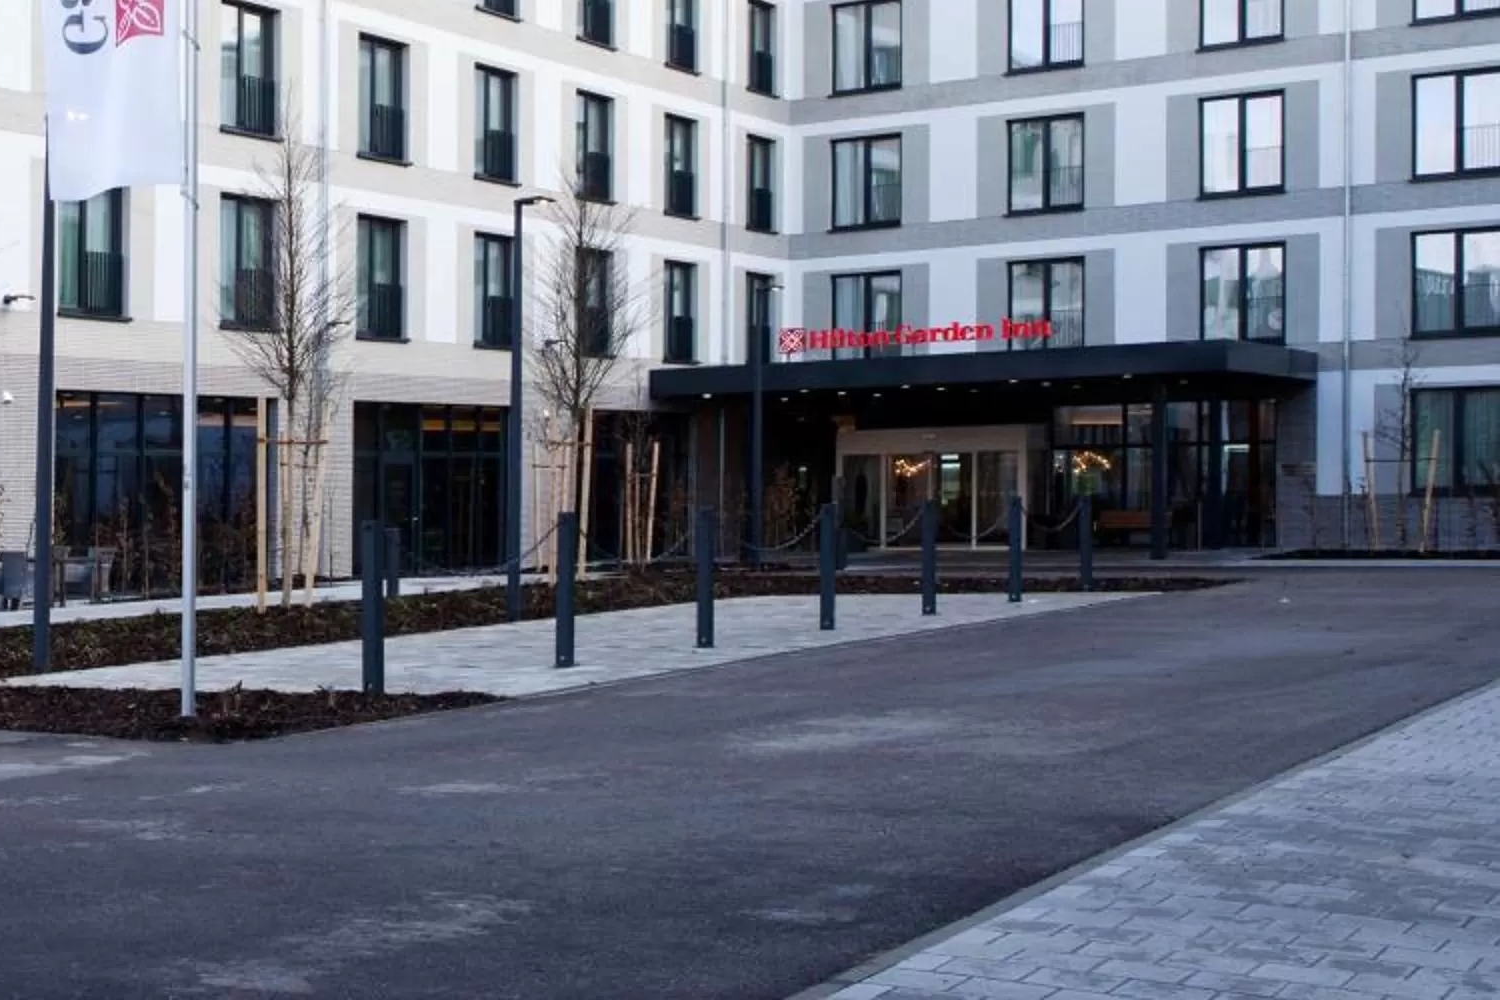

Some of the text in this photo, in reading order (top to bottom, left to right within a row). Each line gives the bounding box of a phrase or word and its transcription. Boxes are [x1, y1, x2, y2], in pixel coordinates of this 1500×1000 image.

[808, 315, 1053, 350] Hilton Garden Inn
